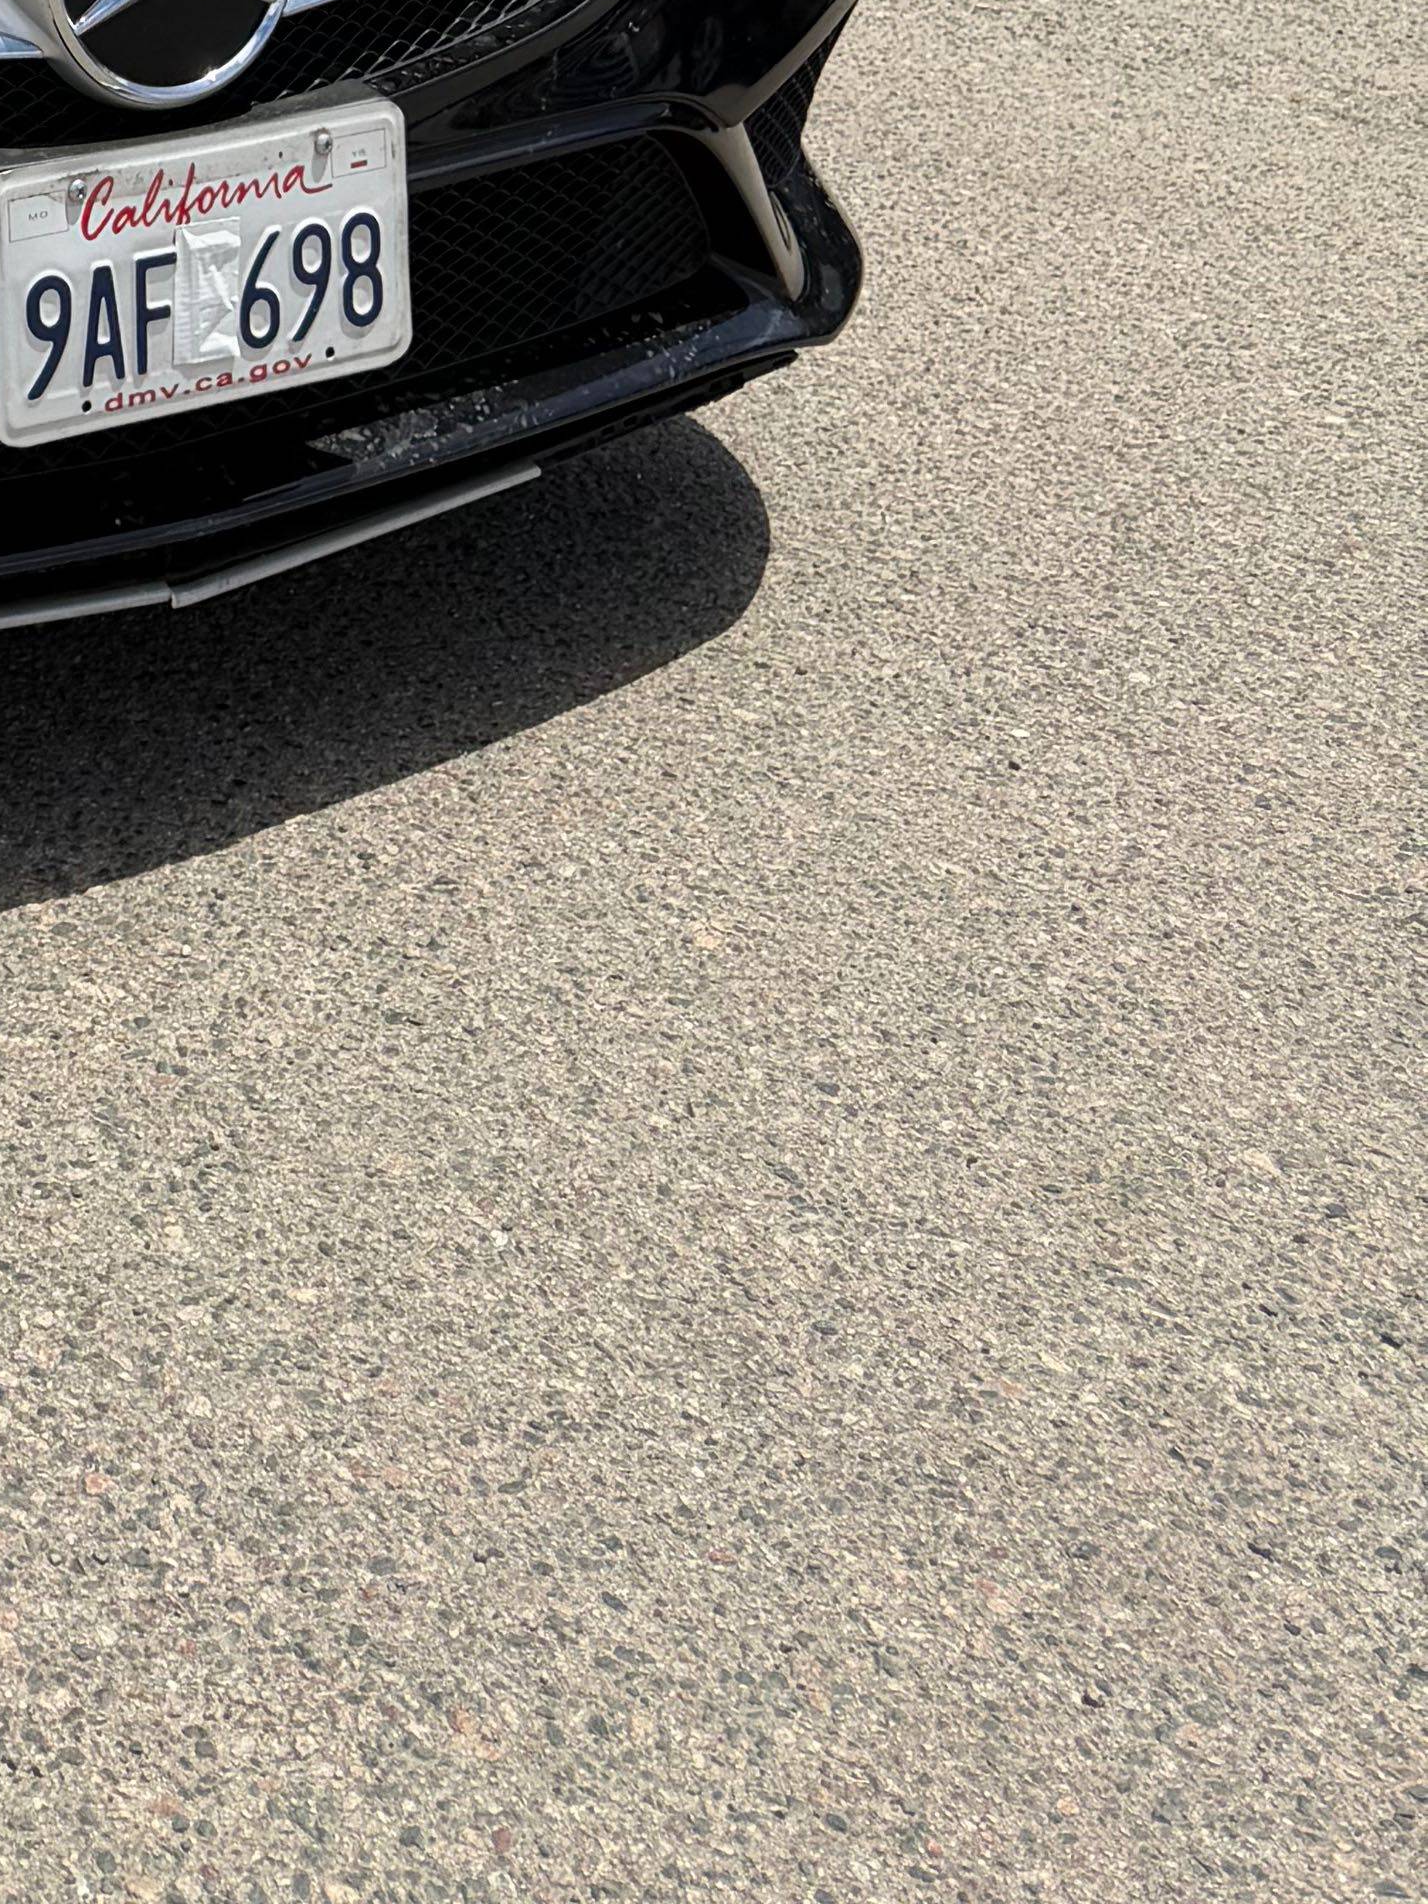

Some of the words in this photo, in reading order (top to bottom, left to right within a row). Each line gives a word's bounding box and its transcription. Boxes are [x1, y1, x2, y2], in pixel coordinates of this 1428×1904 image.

[28, 209, 49, 222] MO
[80, 162, 333, 241] California
[26, 212, 384, 401] 9AF698
[104, 353, 313, 413] dmv.ca.gov
